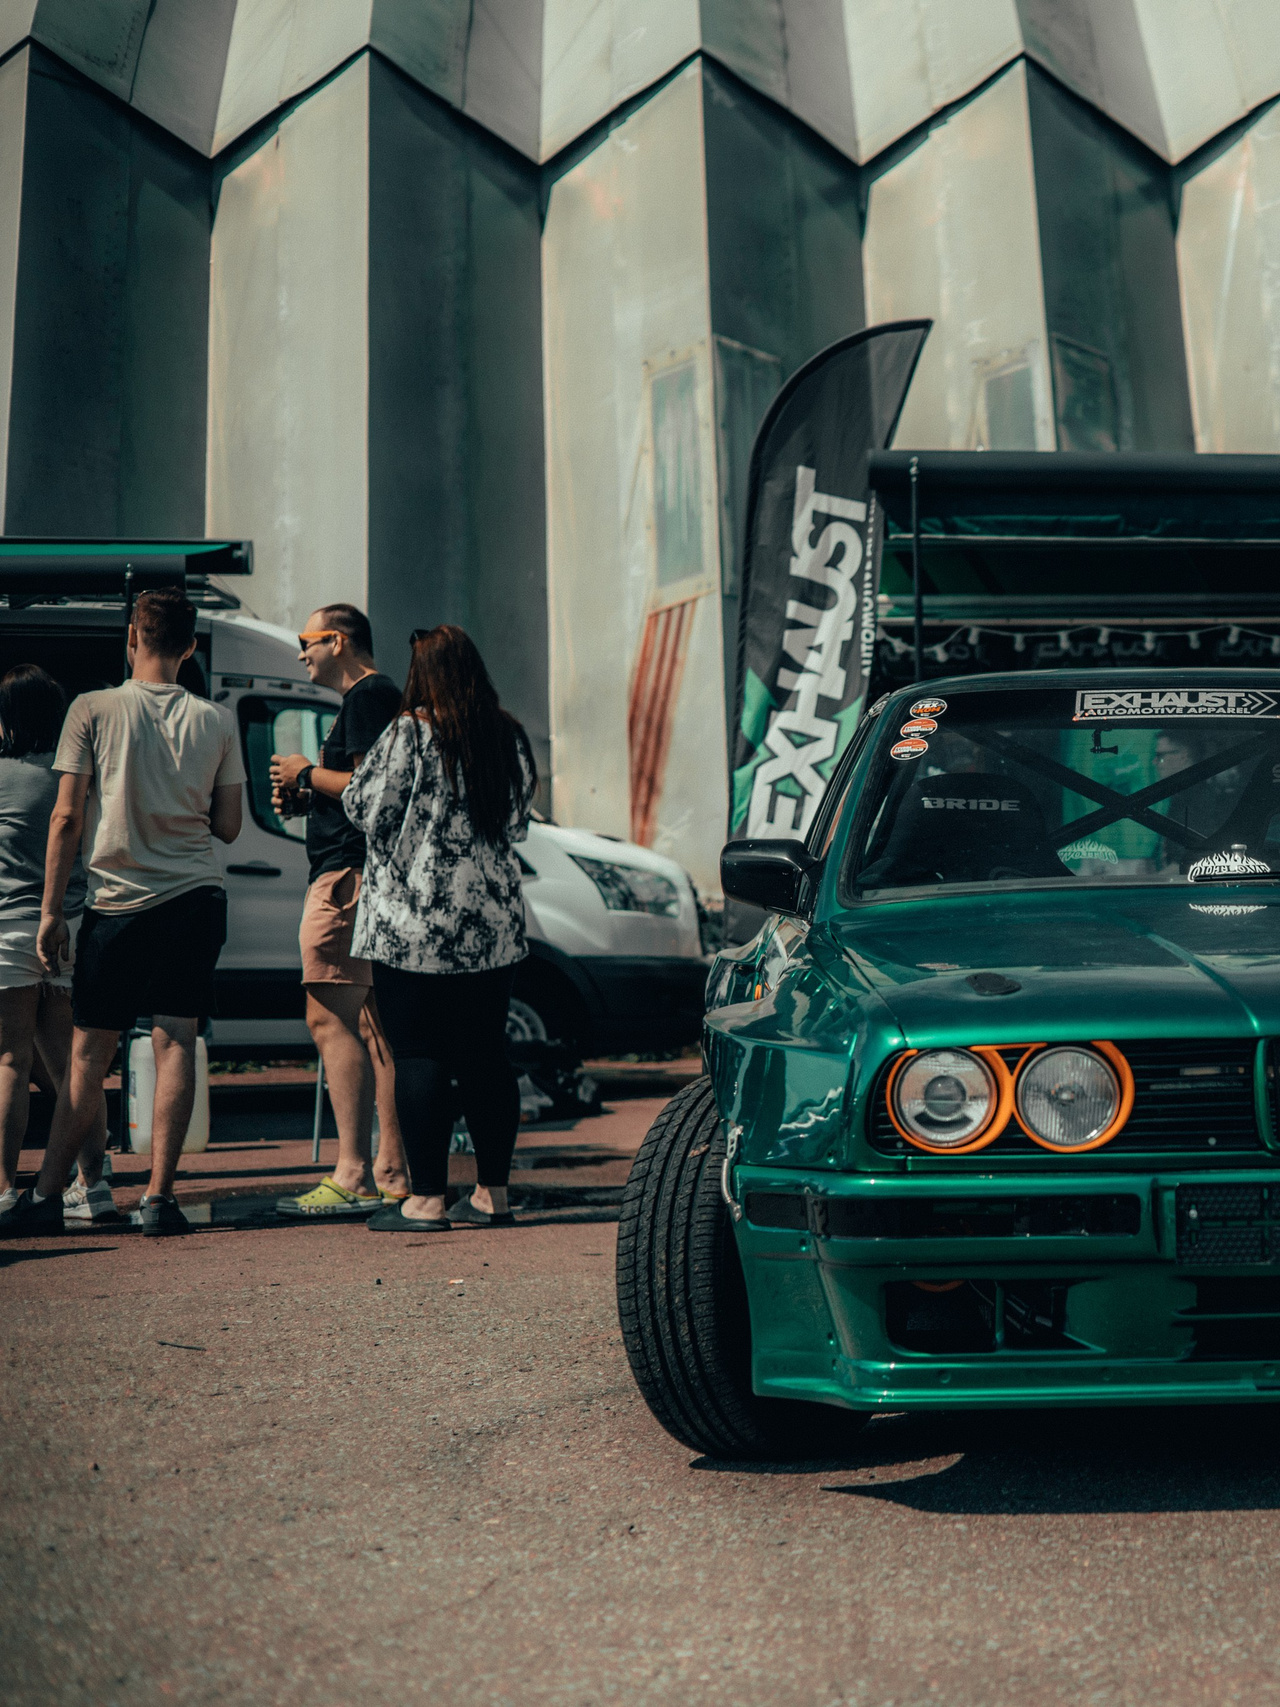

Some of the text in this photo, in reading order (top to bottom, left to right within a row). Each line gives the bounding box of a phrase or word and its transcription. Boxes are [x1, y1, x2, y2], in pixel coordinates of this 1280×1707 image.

[746, 465, 867, 841] EXHAUST
[1084, 692, 1246, 709] EXHAUST
[1088, 706, 1250, 716] AUTOMOTIVE APPAREL
[922, 797, 1020, 811] BRIDE
